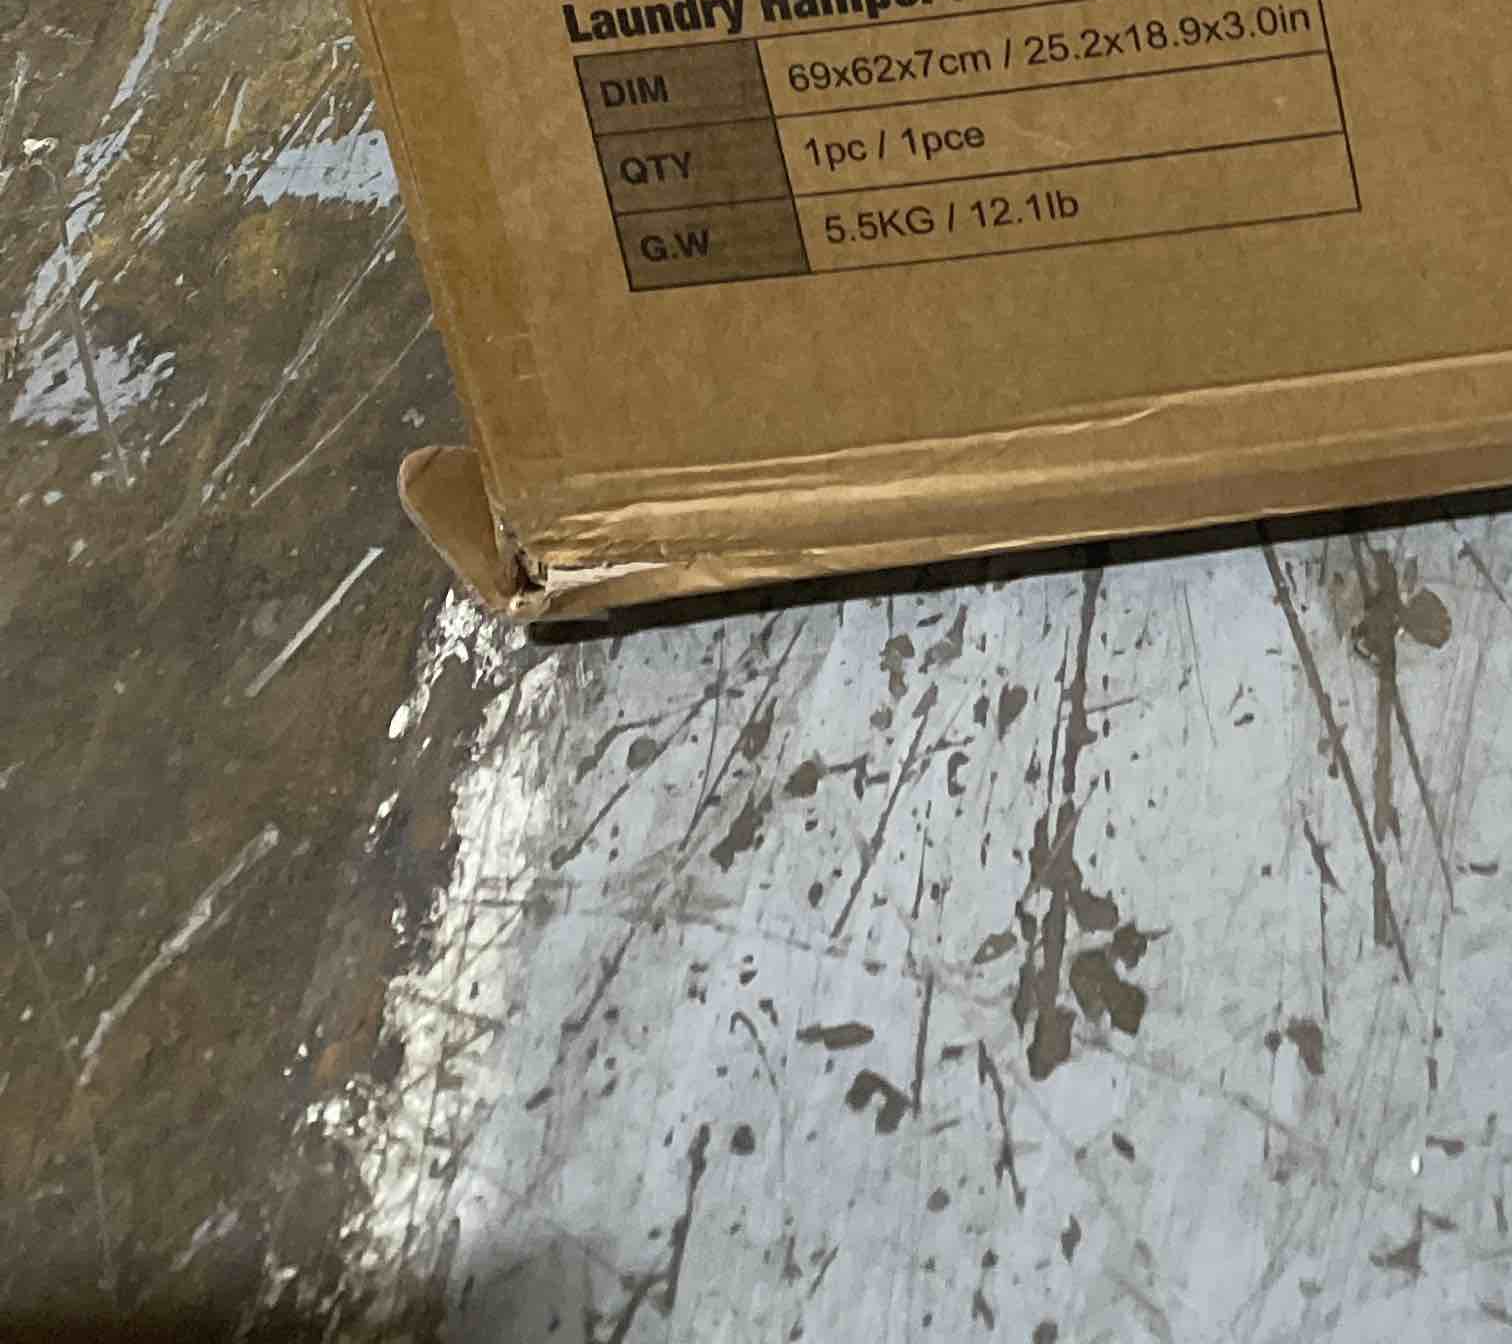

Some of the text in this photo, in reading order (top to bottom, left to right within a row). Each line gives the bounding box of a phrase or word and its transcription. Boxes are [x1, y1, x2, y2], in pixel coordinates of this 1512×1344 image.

[787, 2, 1313, 95] 69x62x7cm / 25.2x18.9x3.0in
[599, 73, 669, 110] DIM
[617, 149, 695, 188] QTY
[803, 121, 987, 173] 1pc / 1pce
[823, 188, 1081, 247] 5.5KG / 12.1lb
[638, 228, 713, 264] G.W
